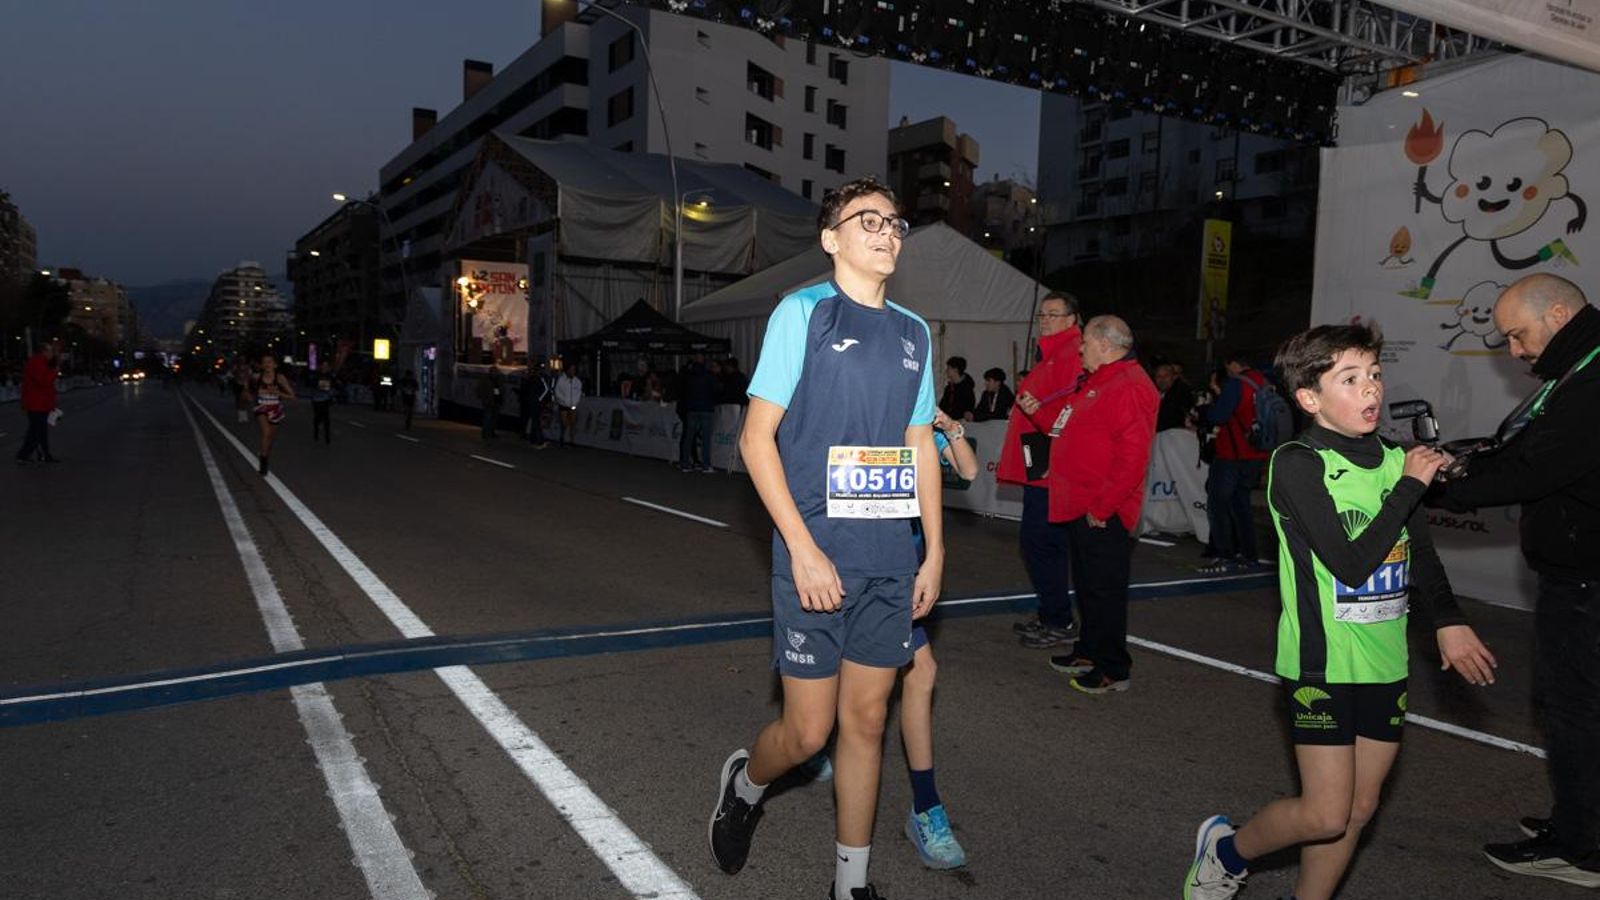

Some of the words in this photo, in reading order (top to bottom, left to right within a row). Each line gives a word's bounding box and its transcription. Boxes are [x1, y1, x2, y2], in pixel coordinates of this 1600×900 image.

[832, 468, 914, 490] 10516
[784, 650, 816, 665] CNSR
[1296, 712, 1333, 723] Unicaja
